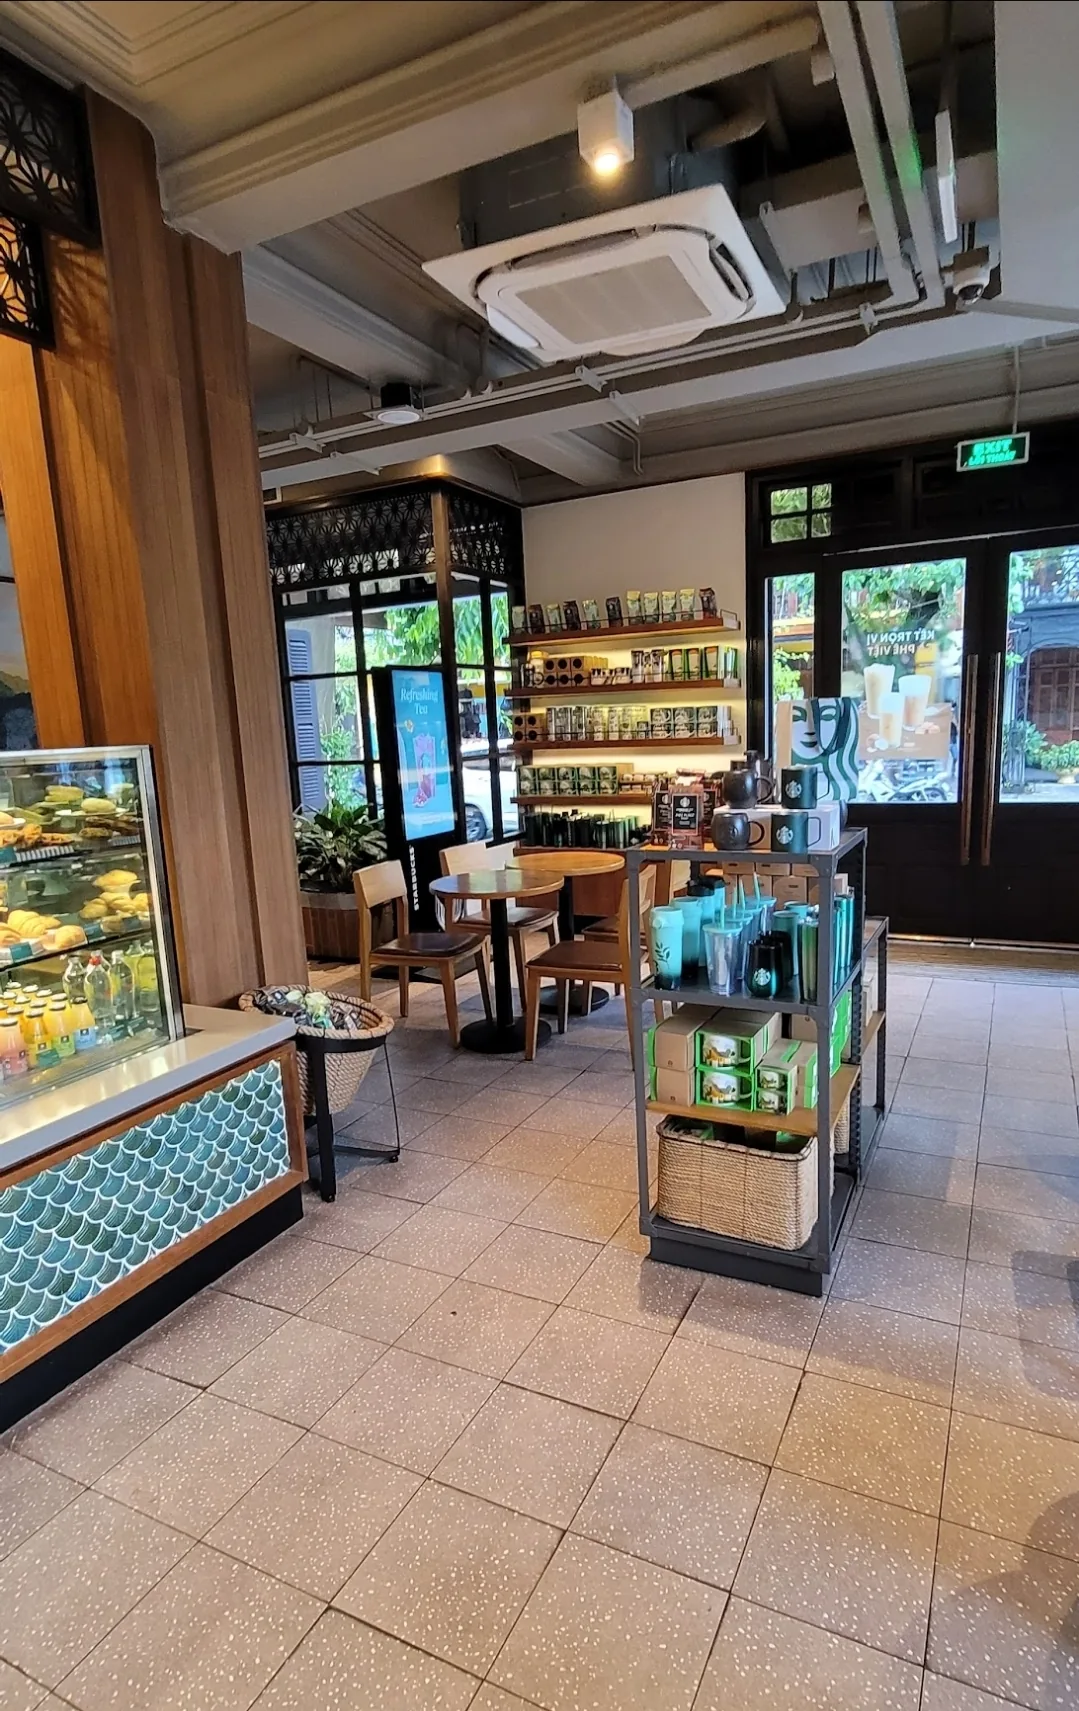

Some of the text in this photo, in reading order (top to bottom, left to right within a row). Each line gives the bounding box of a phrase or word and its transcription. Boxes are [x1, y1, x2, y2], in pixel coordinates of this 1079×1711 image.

[973, 438, 1012, 456] EXIT
[400, 687, 438, 703] Refreshing
[414, 702, 428, 715] Tea
[409, 845, 420, 911] STARBUCKS
